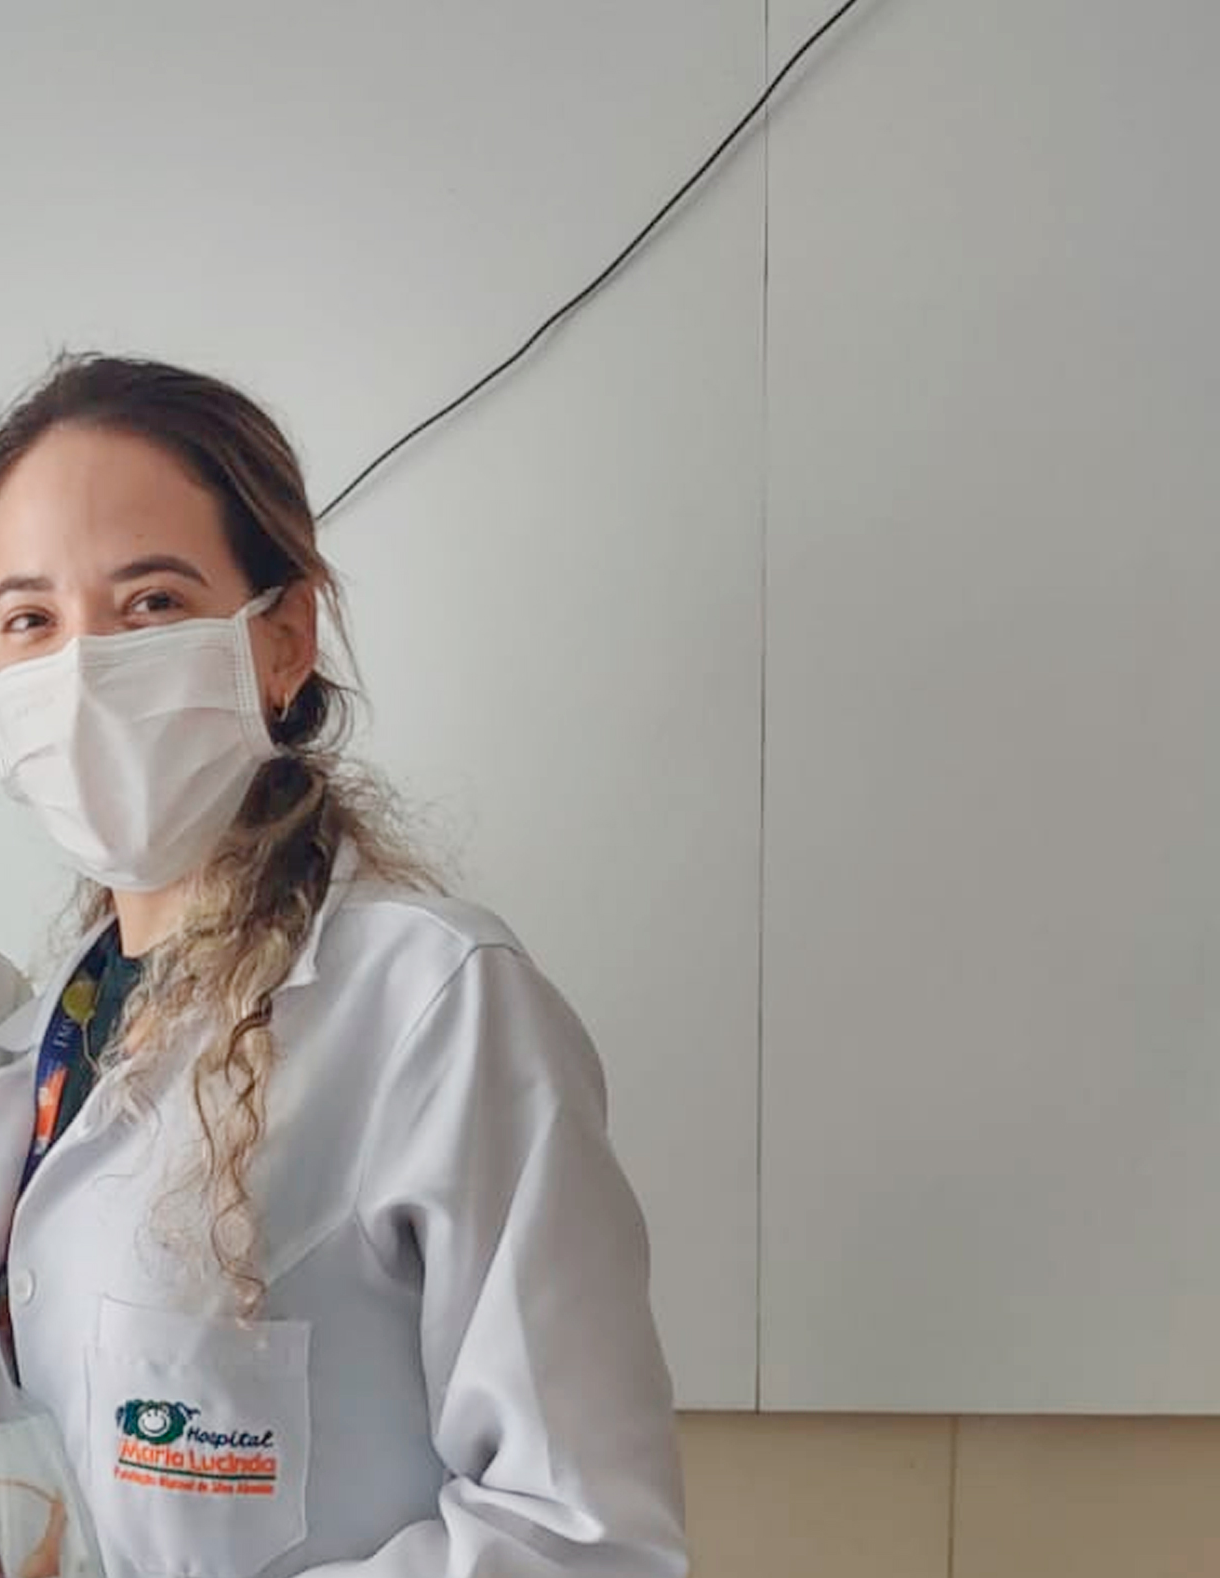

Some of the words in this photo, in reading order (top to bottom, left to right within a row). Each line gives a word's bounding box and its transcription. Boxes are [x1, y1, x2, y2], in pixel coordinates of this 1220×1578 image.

[187, 1427, 274, 1449] Hospital
[120, 1438, 184, 1467] Maria
[189, 1449, 276, 1473] Lucinda
